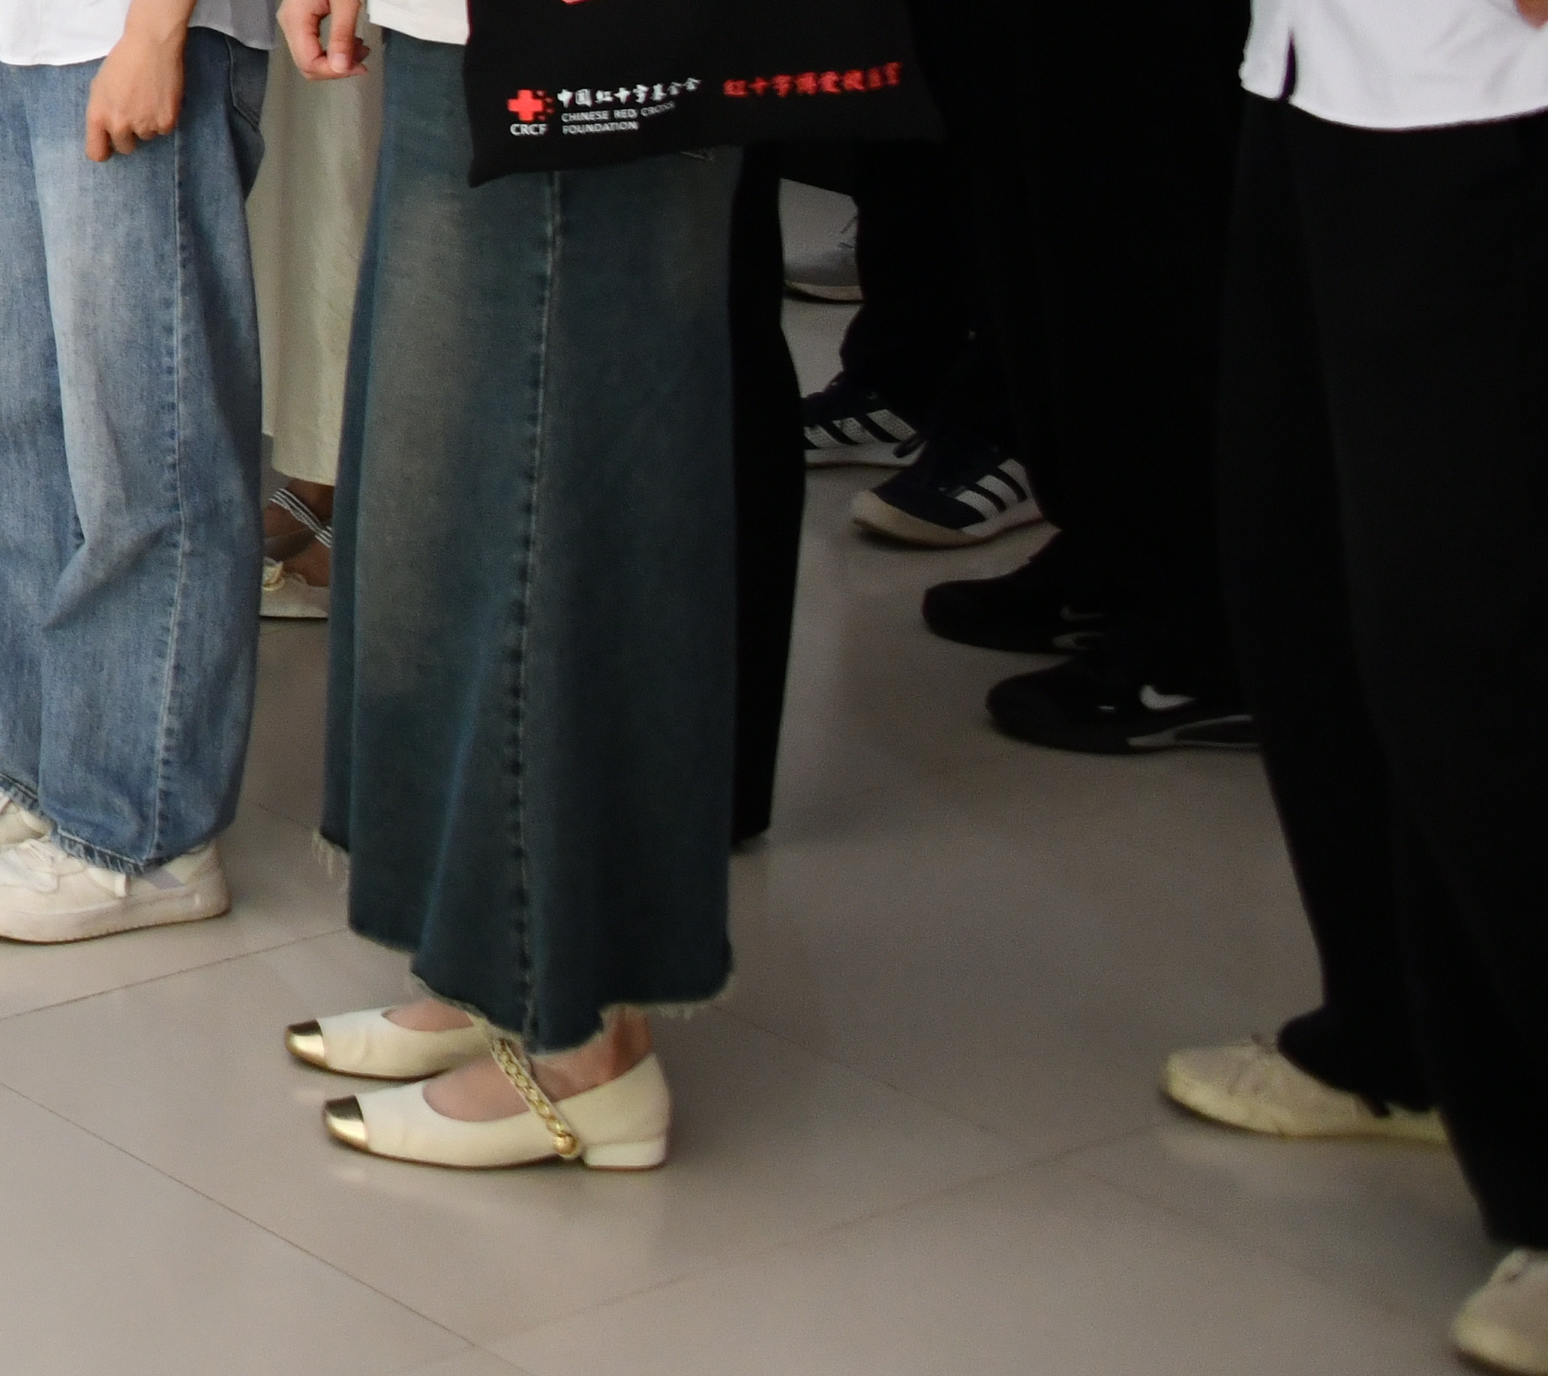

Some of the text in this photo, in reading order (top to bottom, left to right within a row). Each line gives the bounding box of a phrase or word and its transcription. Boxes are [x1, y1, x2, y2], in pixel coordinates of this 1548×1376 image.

[561, 110, 609, 123] CHINESE
[613, 108, 637, 119] RED
[509, 123, 549, 136] CRCF
[562, 120, 639, 135] FOUNDATION
